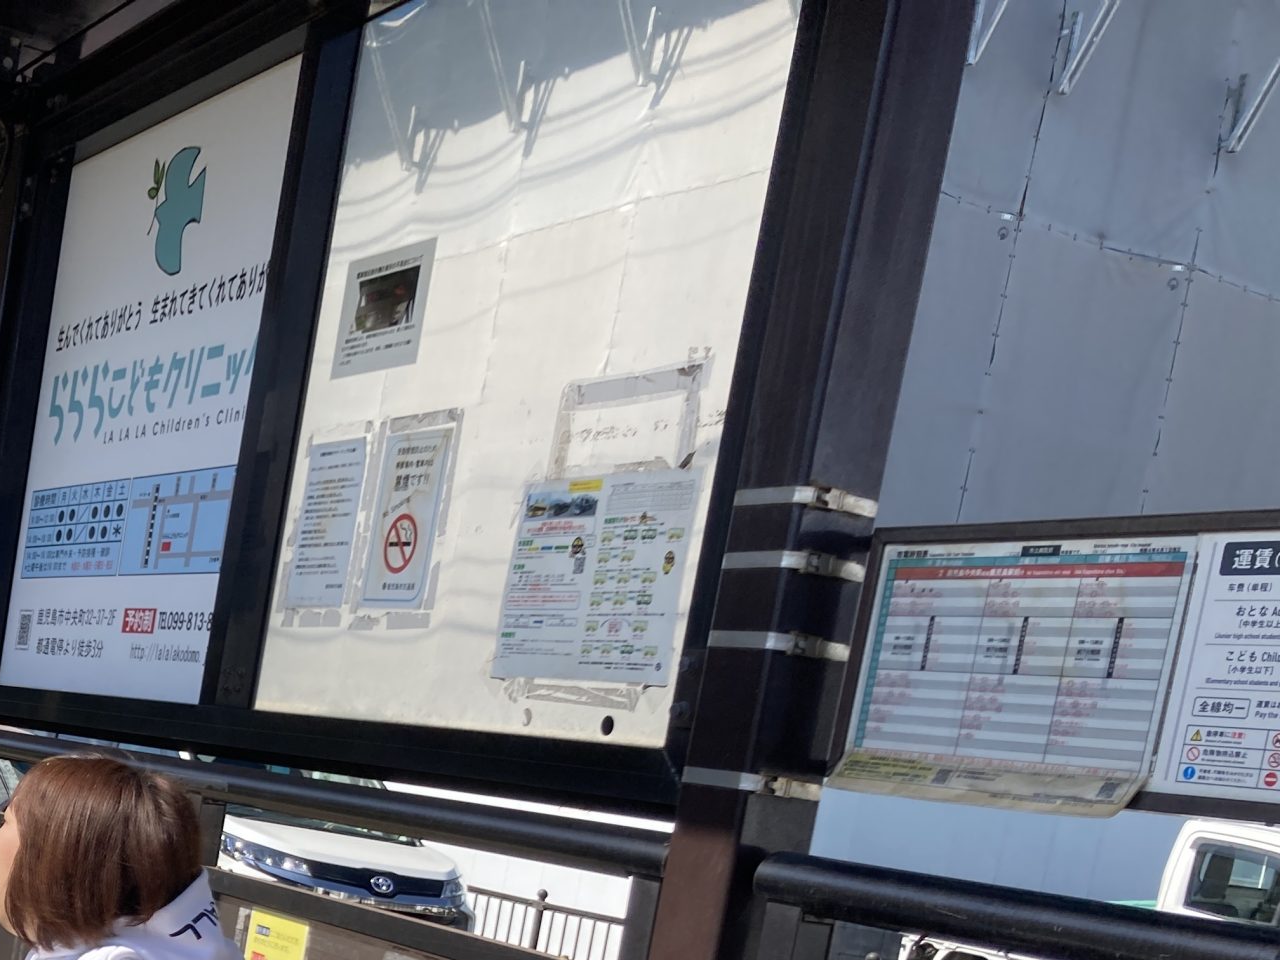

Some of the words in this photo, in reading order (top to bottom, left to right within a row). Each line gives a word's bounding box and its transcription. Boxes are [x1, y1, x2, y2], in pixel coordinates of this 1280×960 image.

[56, 302, 142, 352] 生んでくれてありがとう
[103, 431, 114, 444] LA
[119, 428, 130, 442] LA
[135, 425, 147, 439] LA
[152, 413, 210, 437] Children's
[106, 486, 113, 497] 金
[118, 485, 125, 496] 土
[1236, 605, 1269, 617] おとな
[125, 610, 153, 632] 予約制
[1226, 651, 1257, 662] こども
[1198, 701, 1245, 714] 全線均一
